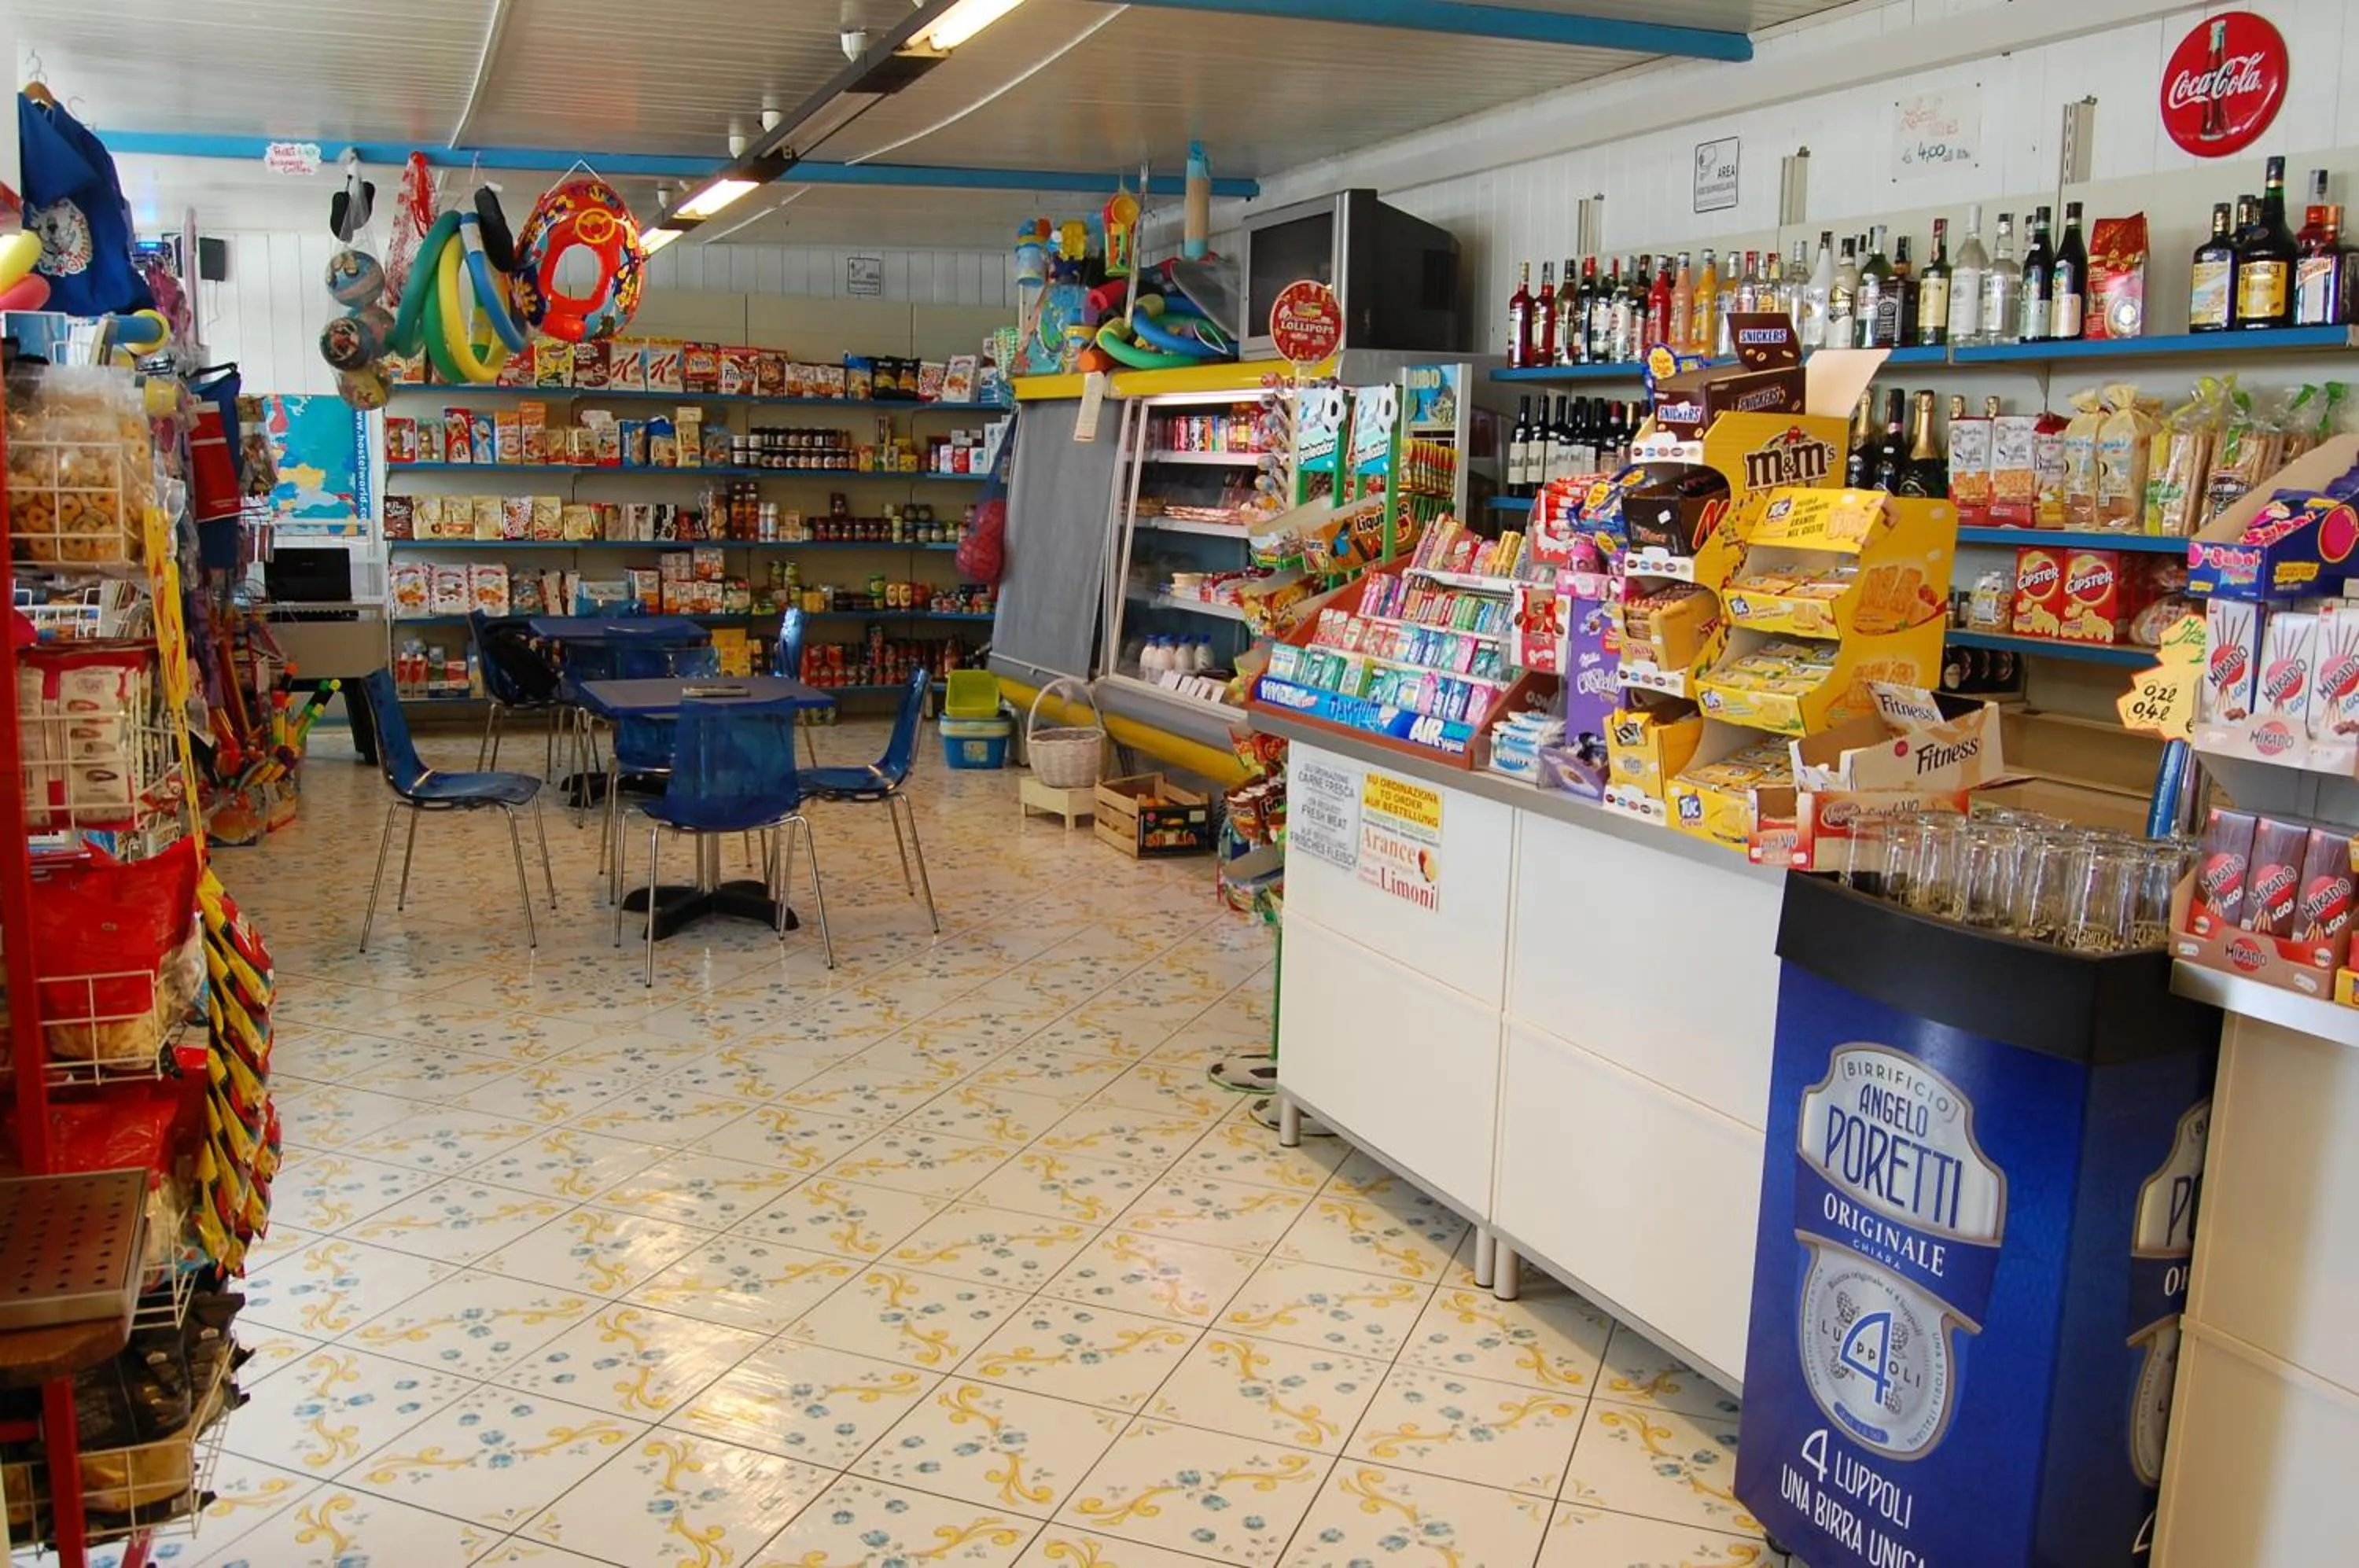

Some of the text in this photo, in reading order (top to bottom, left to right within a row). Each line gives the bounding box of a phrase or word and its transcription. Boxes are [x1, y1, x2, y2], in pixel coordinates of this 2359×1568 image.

[1281, 319, 1334, 334] LOLLIPOPS
[1739, 329, 1787, 342] SNICKERS
[356, 410, 370, 521] ww.hostelworld.co
[2208, 645, 2248, 687] MIKADO
[2262, 658, 2307, 703] MIKADO
[1879, 694, 1935, 722] Fitness
[1409, 715, 1444, 748] AIR
[2249, 730, 2295, 749] MIKADO
[1916, 735, 1978, 776] Fitness
[1367, 773, 1439, 804] SU ORDINAZIONE
[1380, 790, 1422, 811] TO ORDER
[1301, 804, 1326, 823] FRESH
[1364, 797, 1438, 828] AUF BESTELLUNG
[1364, 827, 1416, 864] Arance
[1381, 867, 1435, 911] Limoni
[2202, 853, 2245, 893] MIKADO
[2249, 865, 2297, 907] MIKADO
[2301, 878, 2351, 920] MIKADO
[2225, 944, 2267, 966] MIKADO
[1848, 1062, 1949, 1113] BIRRIFICIO
[1859, 1083, 1929, 1139] ANGELO
[1824, 1104, 1963, 1229] PORETTI
[1824, 1192, 1946, 1278] ORIGINALE
[1852, 1240, 1901, 1271] CHIARA
[1839, 1312, 1893, 1405] 4
[1801, 1429, 1913, 1529] 4 LUPPOLI
[1781, 1463, 1810, 1516] UNA
[1814, 1491, 1863, 1556] BIRRA
